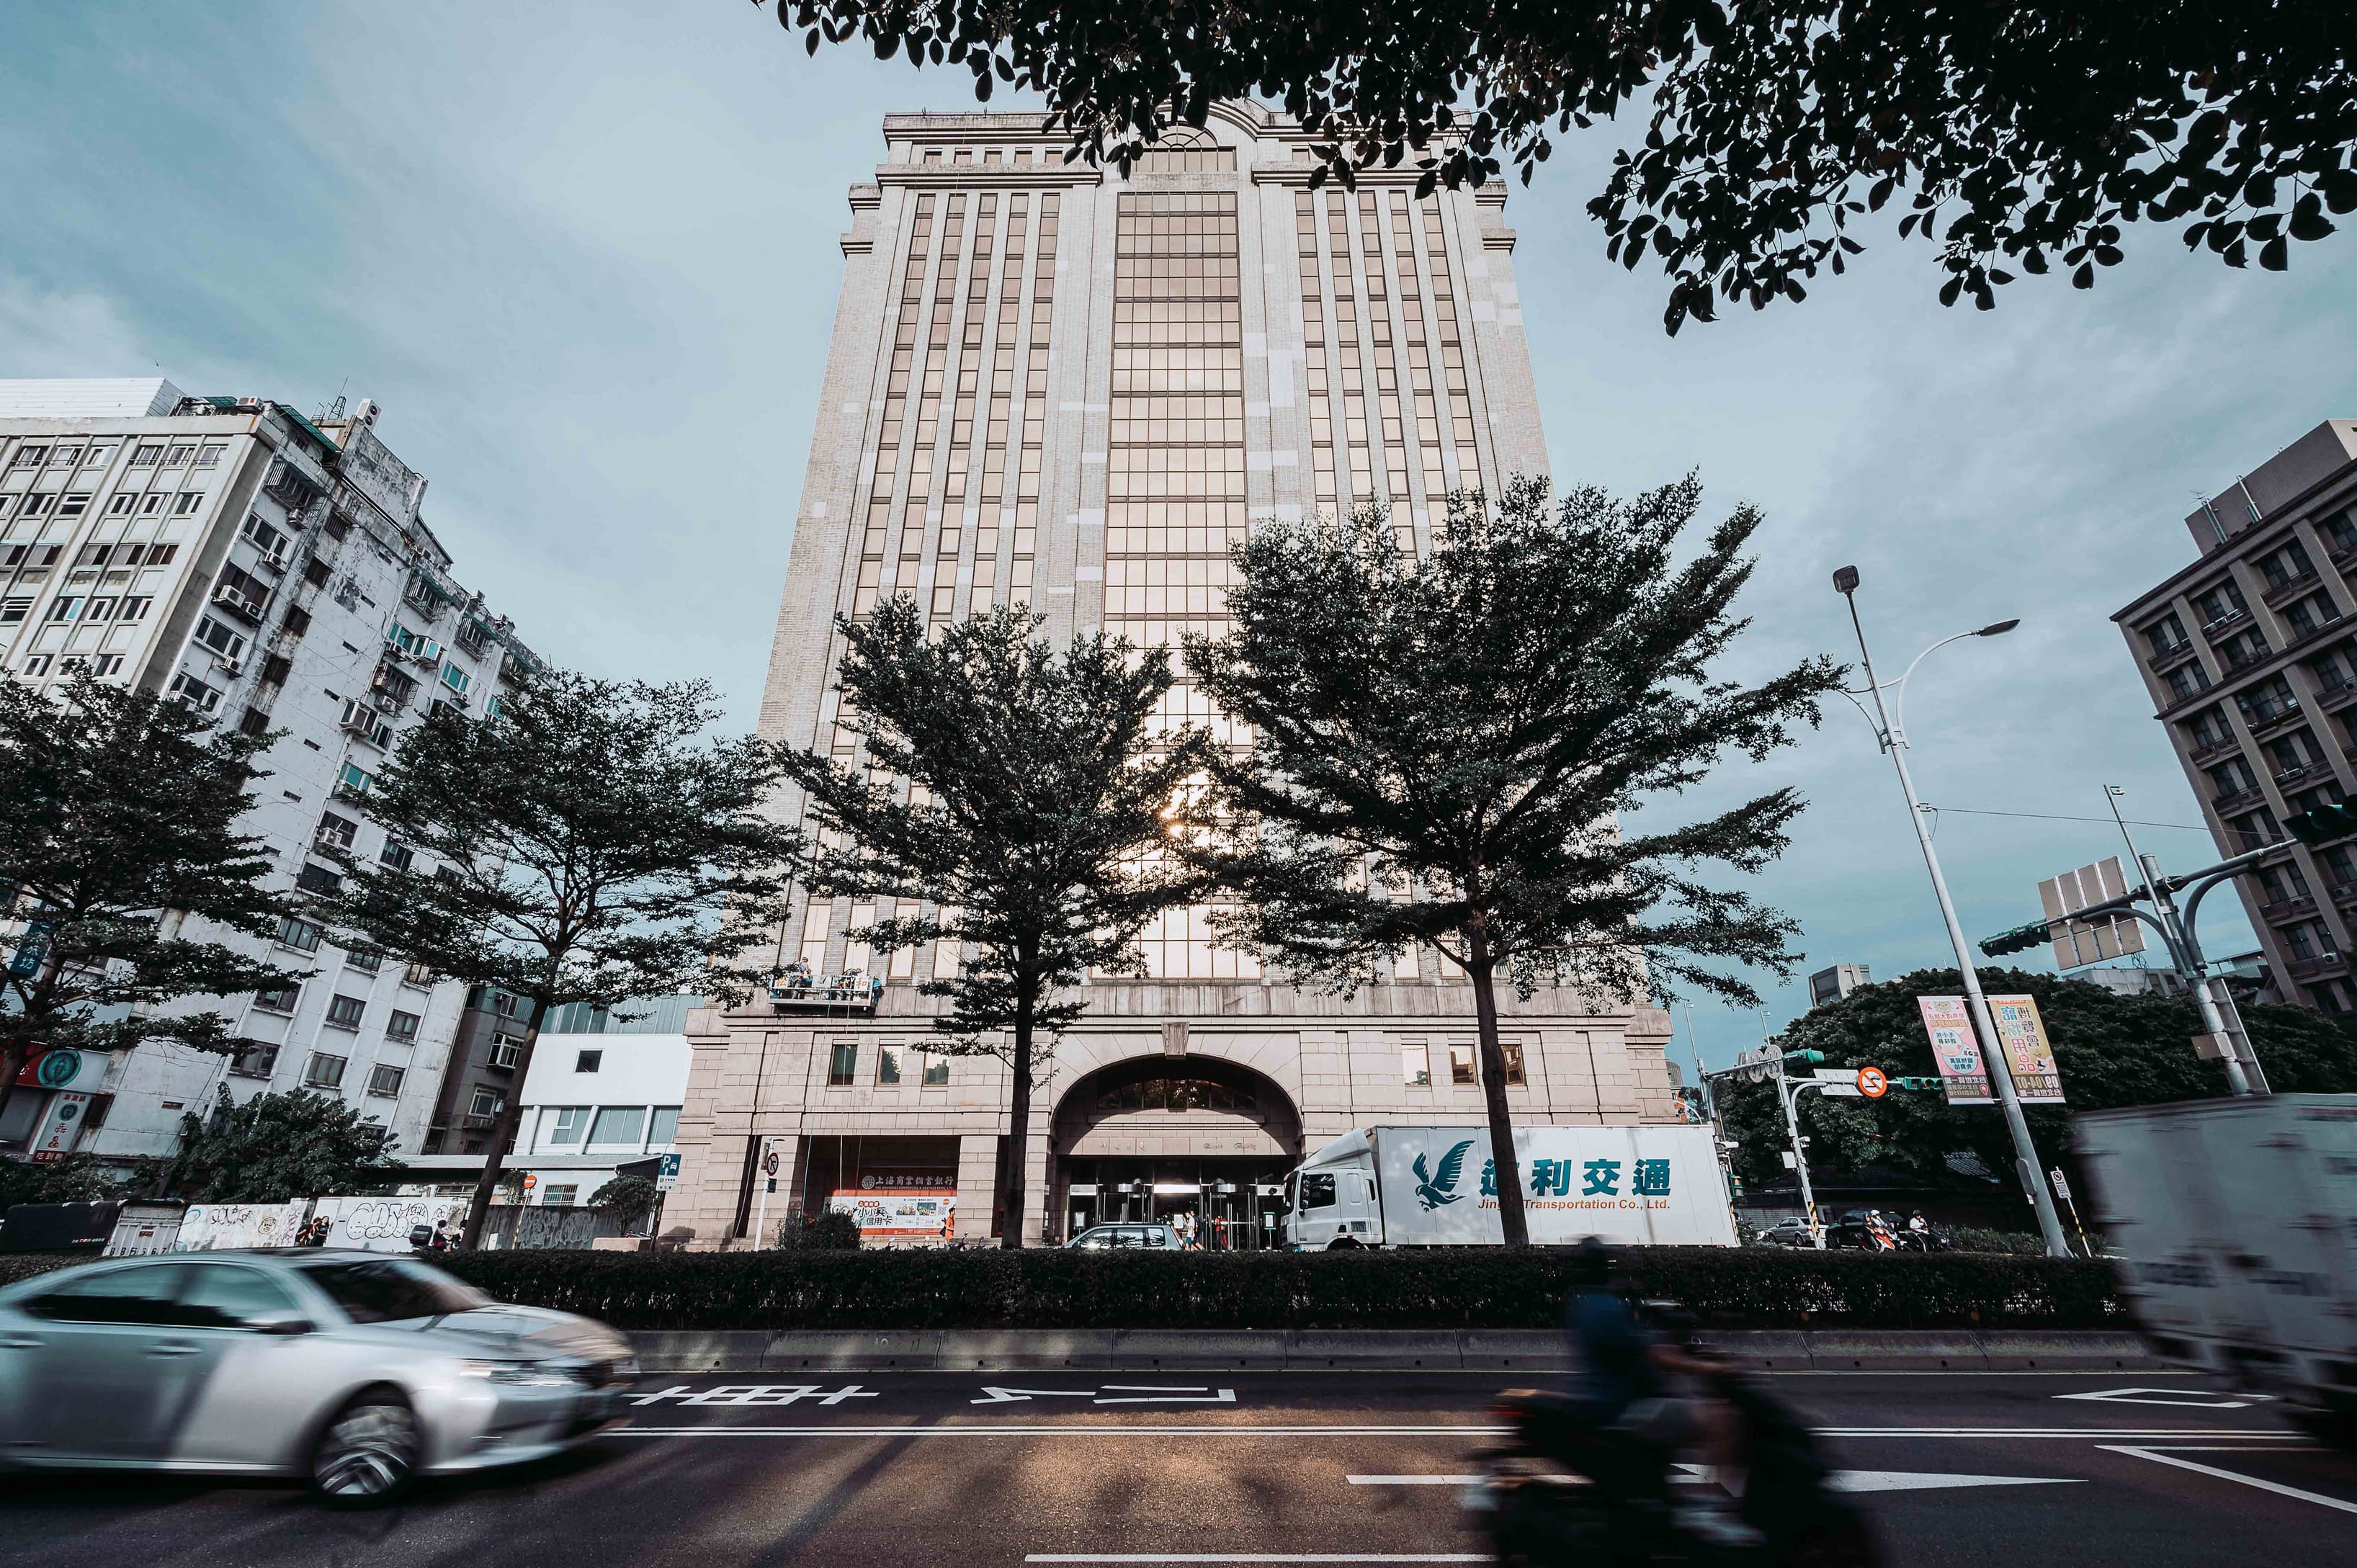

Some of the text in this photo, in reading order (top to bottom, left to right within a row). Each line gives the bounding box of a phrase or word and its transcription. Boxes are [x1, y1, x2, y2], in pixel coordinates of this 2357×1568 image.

[662, 1155, 671, 1168] P
[1524, 1199, 1615, 1211] Transportation
[1619, 1199, 1643, 1211] Co.,
[1647, 1199, 1671, 1209] Ltd.
[866, 1215, 893, 1226] 信用卡
